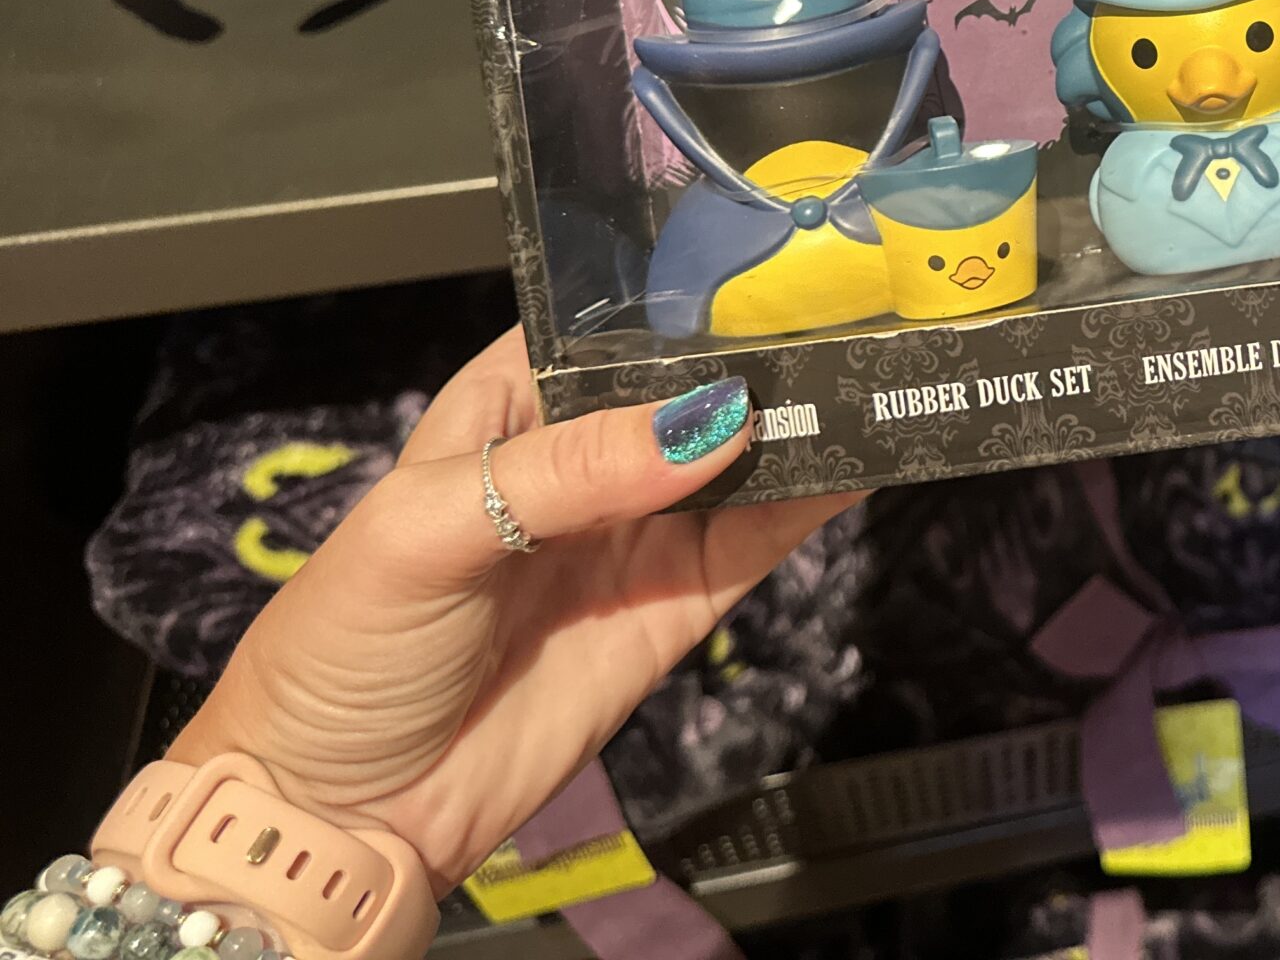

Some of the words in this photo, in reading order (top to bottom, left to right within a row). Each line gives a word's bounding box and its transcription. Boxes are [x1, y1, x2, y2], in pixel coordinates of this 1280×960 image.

[1141, 341, 1263, 385] ENSEMBLE
[871, 381, 970, 422] RUBBER
[977, 371, 1042, 408] DUCK
[1050, 364, 1093, 398] SET
[751, 399, 821, 442] ansion
